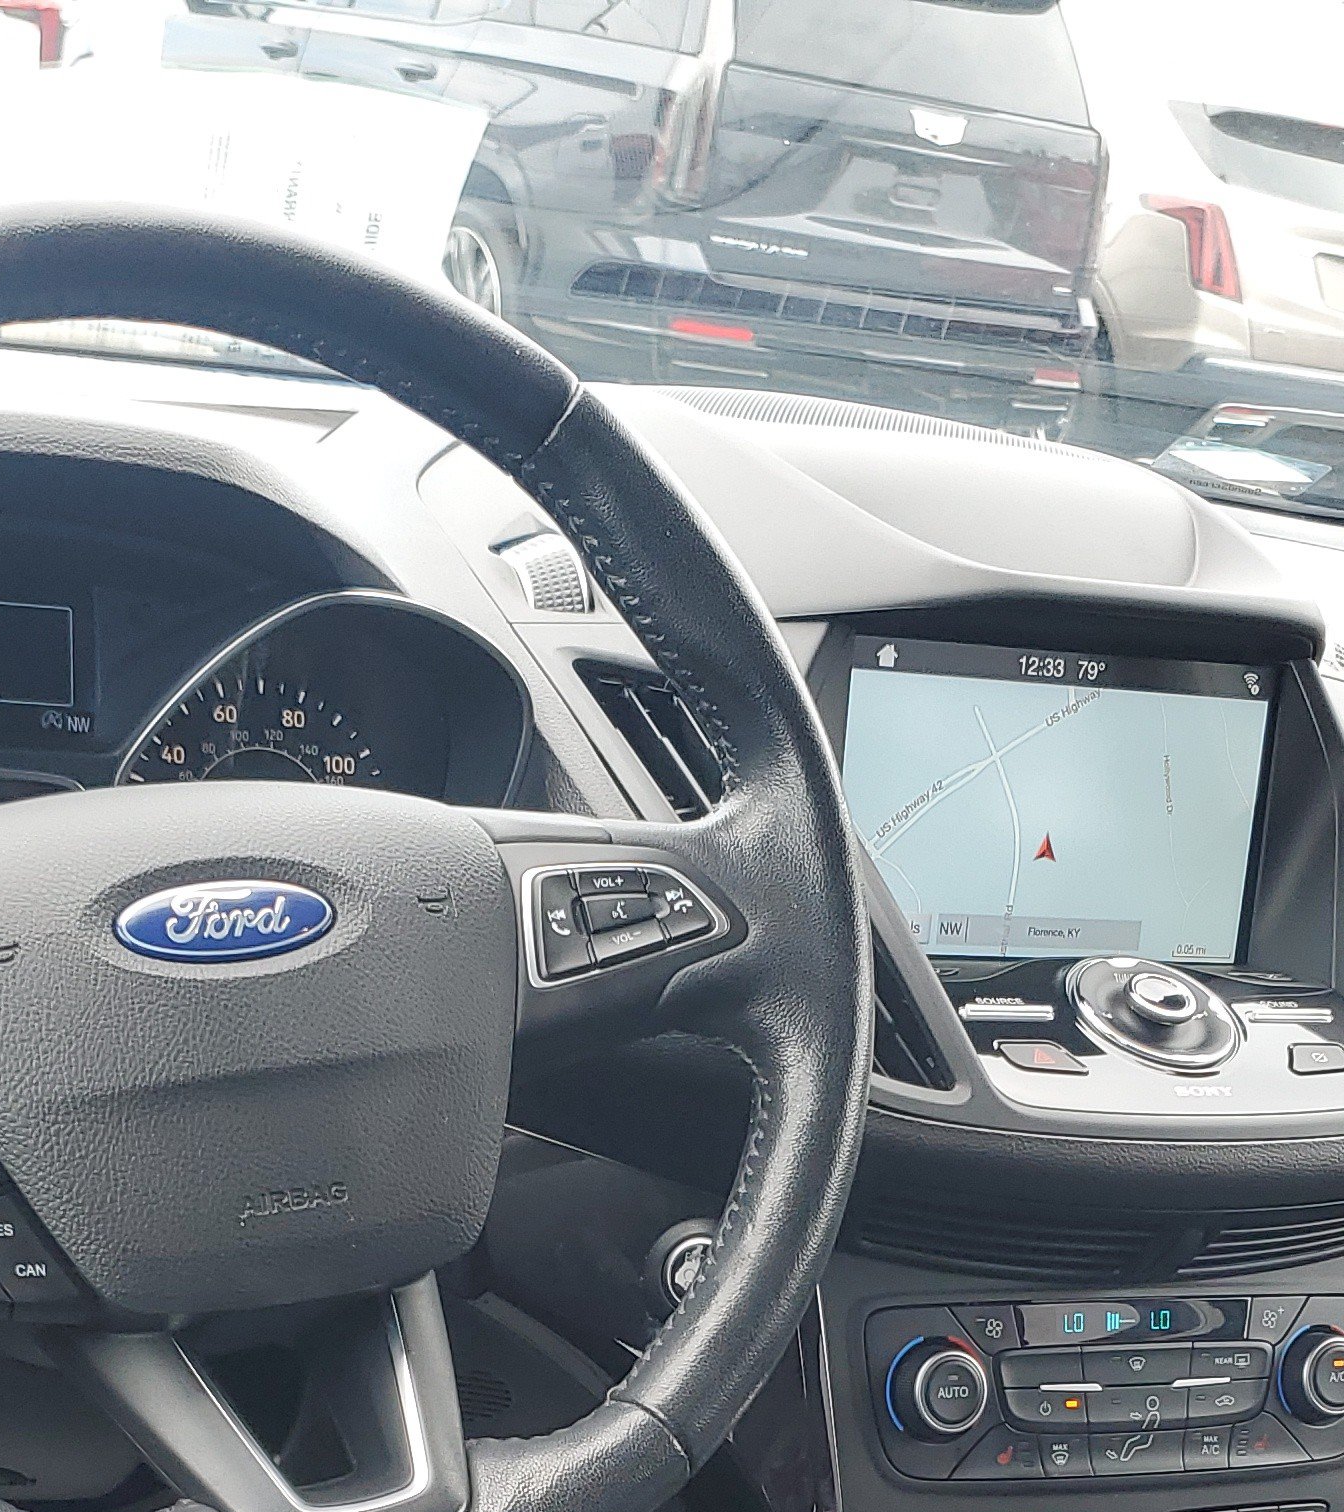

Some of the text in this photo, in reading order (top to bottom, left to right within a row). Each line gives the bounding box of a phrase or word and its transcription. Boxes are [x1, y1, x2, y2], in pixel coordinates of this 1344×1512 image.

[1018, 655, 1065, 678] 12:33
[213, 704, 238, 724] 60
[1045, 687, 1102, 728] US Highway
[66, 716, 92, 733] NW
[281, 708, 306, 729] 80
[160, 746, 186, 765] 40
[322, 754, 355, 775] 100
[875, 779, 945, 839] US Highway 42
[165, 886, 292, 944] Ford
[938, 920, 963, 936] NW
[1027, 926, 1081, 939] Florence, KY
[1176, 943, 1194, 955] 0.05
[974, 996, 1026, 1005] SOURCE
[14, 1262, 47, 1278] CAN
[1214, 1356, 1233, 1365] REAR
[937, 1385, 969, 1399] AUTO
[1052, 1442, 1069, 1451] MAX
[1203, 1434, 1219, 1443] MAX
[1200, 1445, 1220, 1456] A/C
